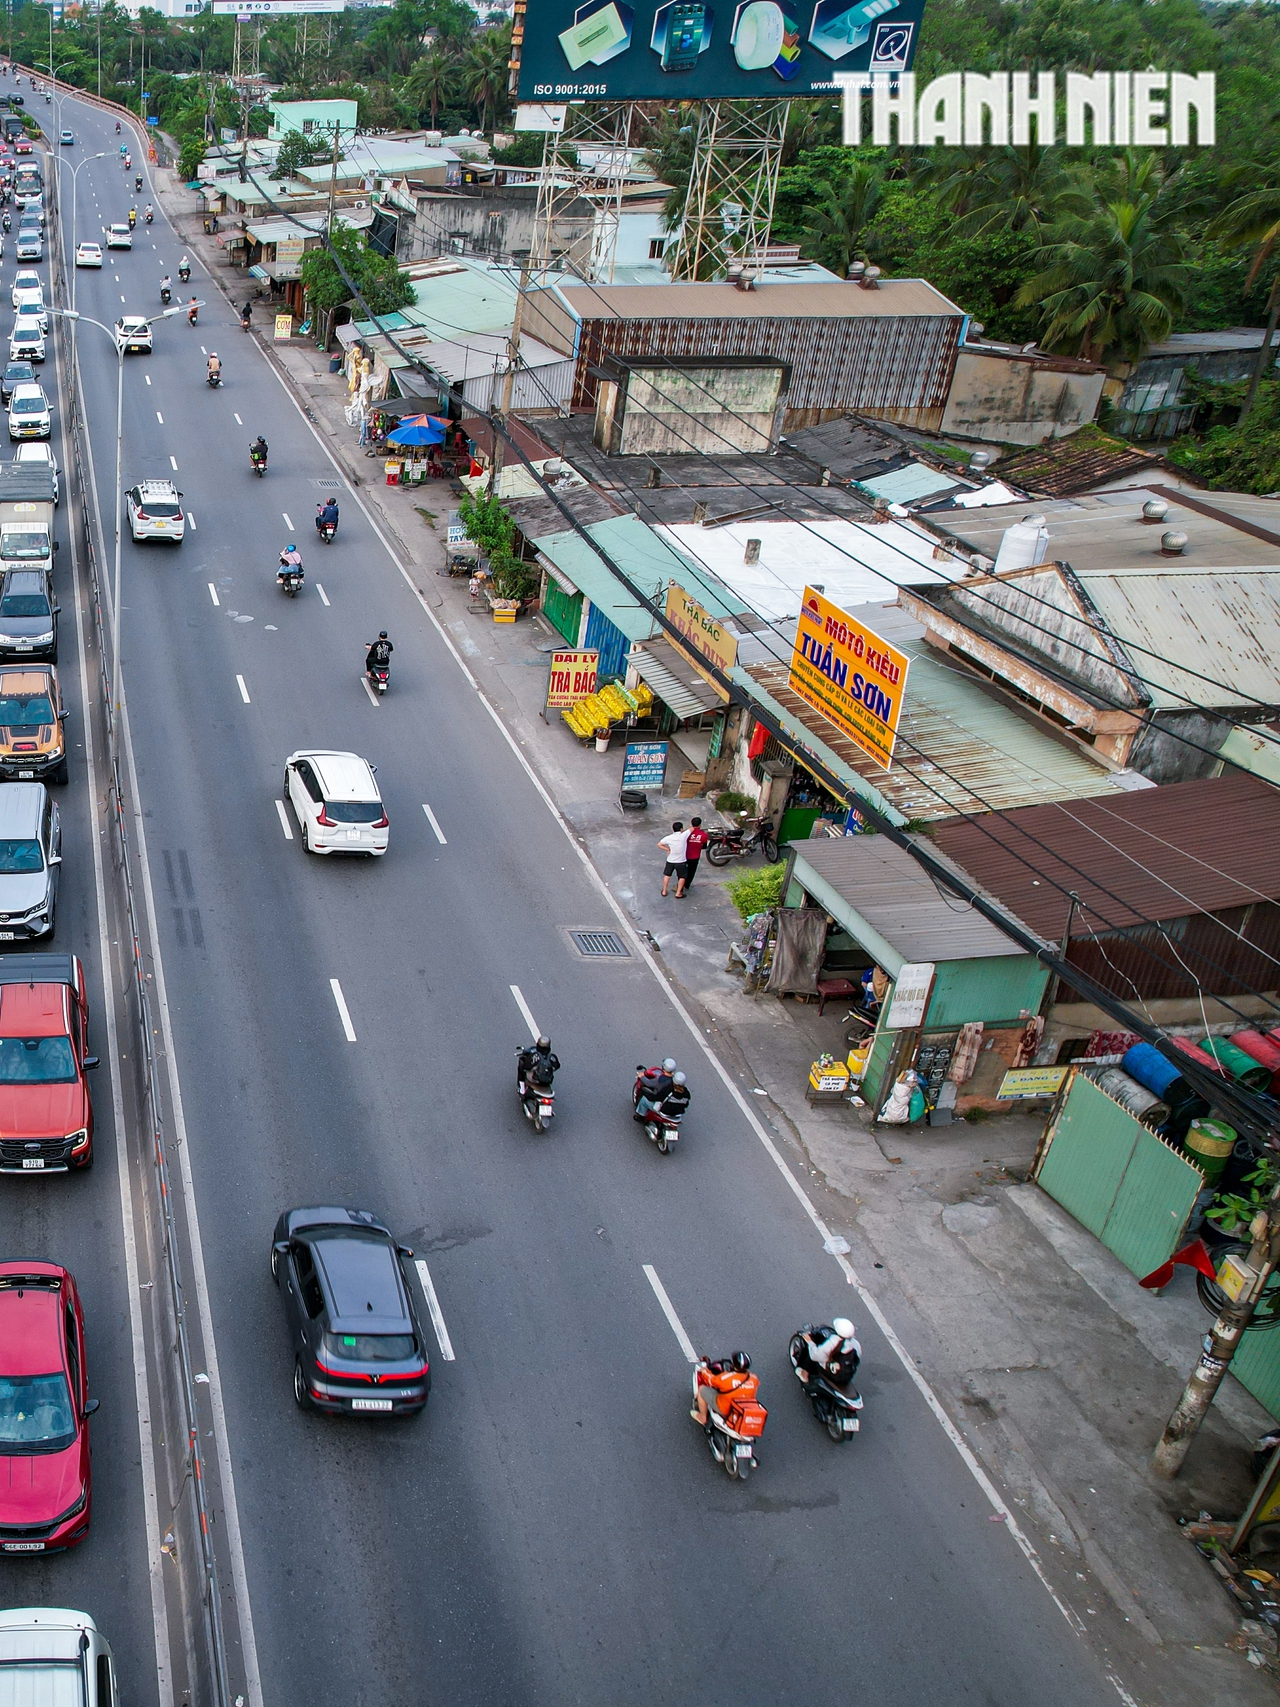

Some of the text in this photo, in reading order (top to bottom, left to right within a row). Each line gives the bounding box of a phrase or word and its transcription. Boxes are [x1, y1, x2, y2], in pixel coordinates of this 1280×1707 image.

[533, 84, 607, 95] ISO 9001:2015
[825, 615, 866, 659] MÔTÔ
[554, 653, 597, 664] ĐẠI LÝ
[551, 664, 597, 693] TRÀ BẮC
[850, 672, 892, 723] SƠN
